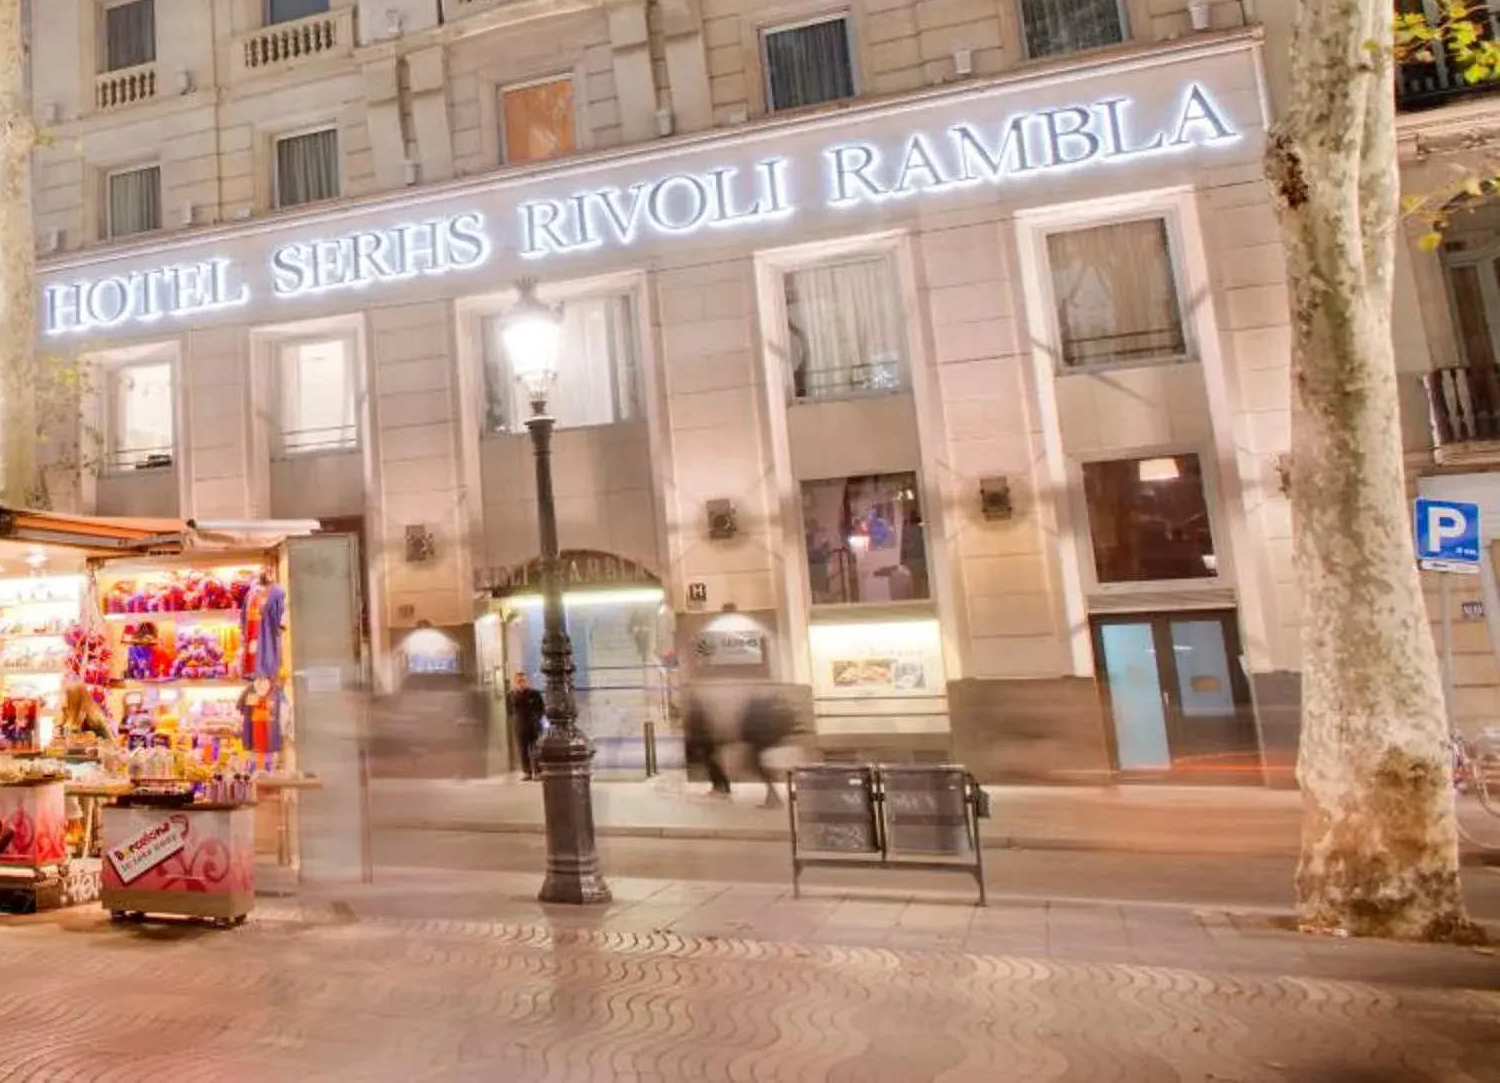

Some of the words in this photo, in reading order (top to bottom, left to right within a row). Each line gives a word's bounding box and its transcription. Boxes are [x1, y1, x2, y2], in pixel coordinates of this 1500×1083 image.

[45, 257, 250, 336] HOTEL
[270, 212, 493, 297] SERHS
[517, 157, 791, 260] RIVOLI
[828, 80, 1242, 209] RAMBLA
[1426, 505, 1467, 552] P
